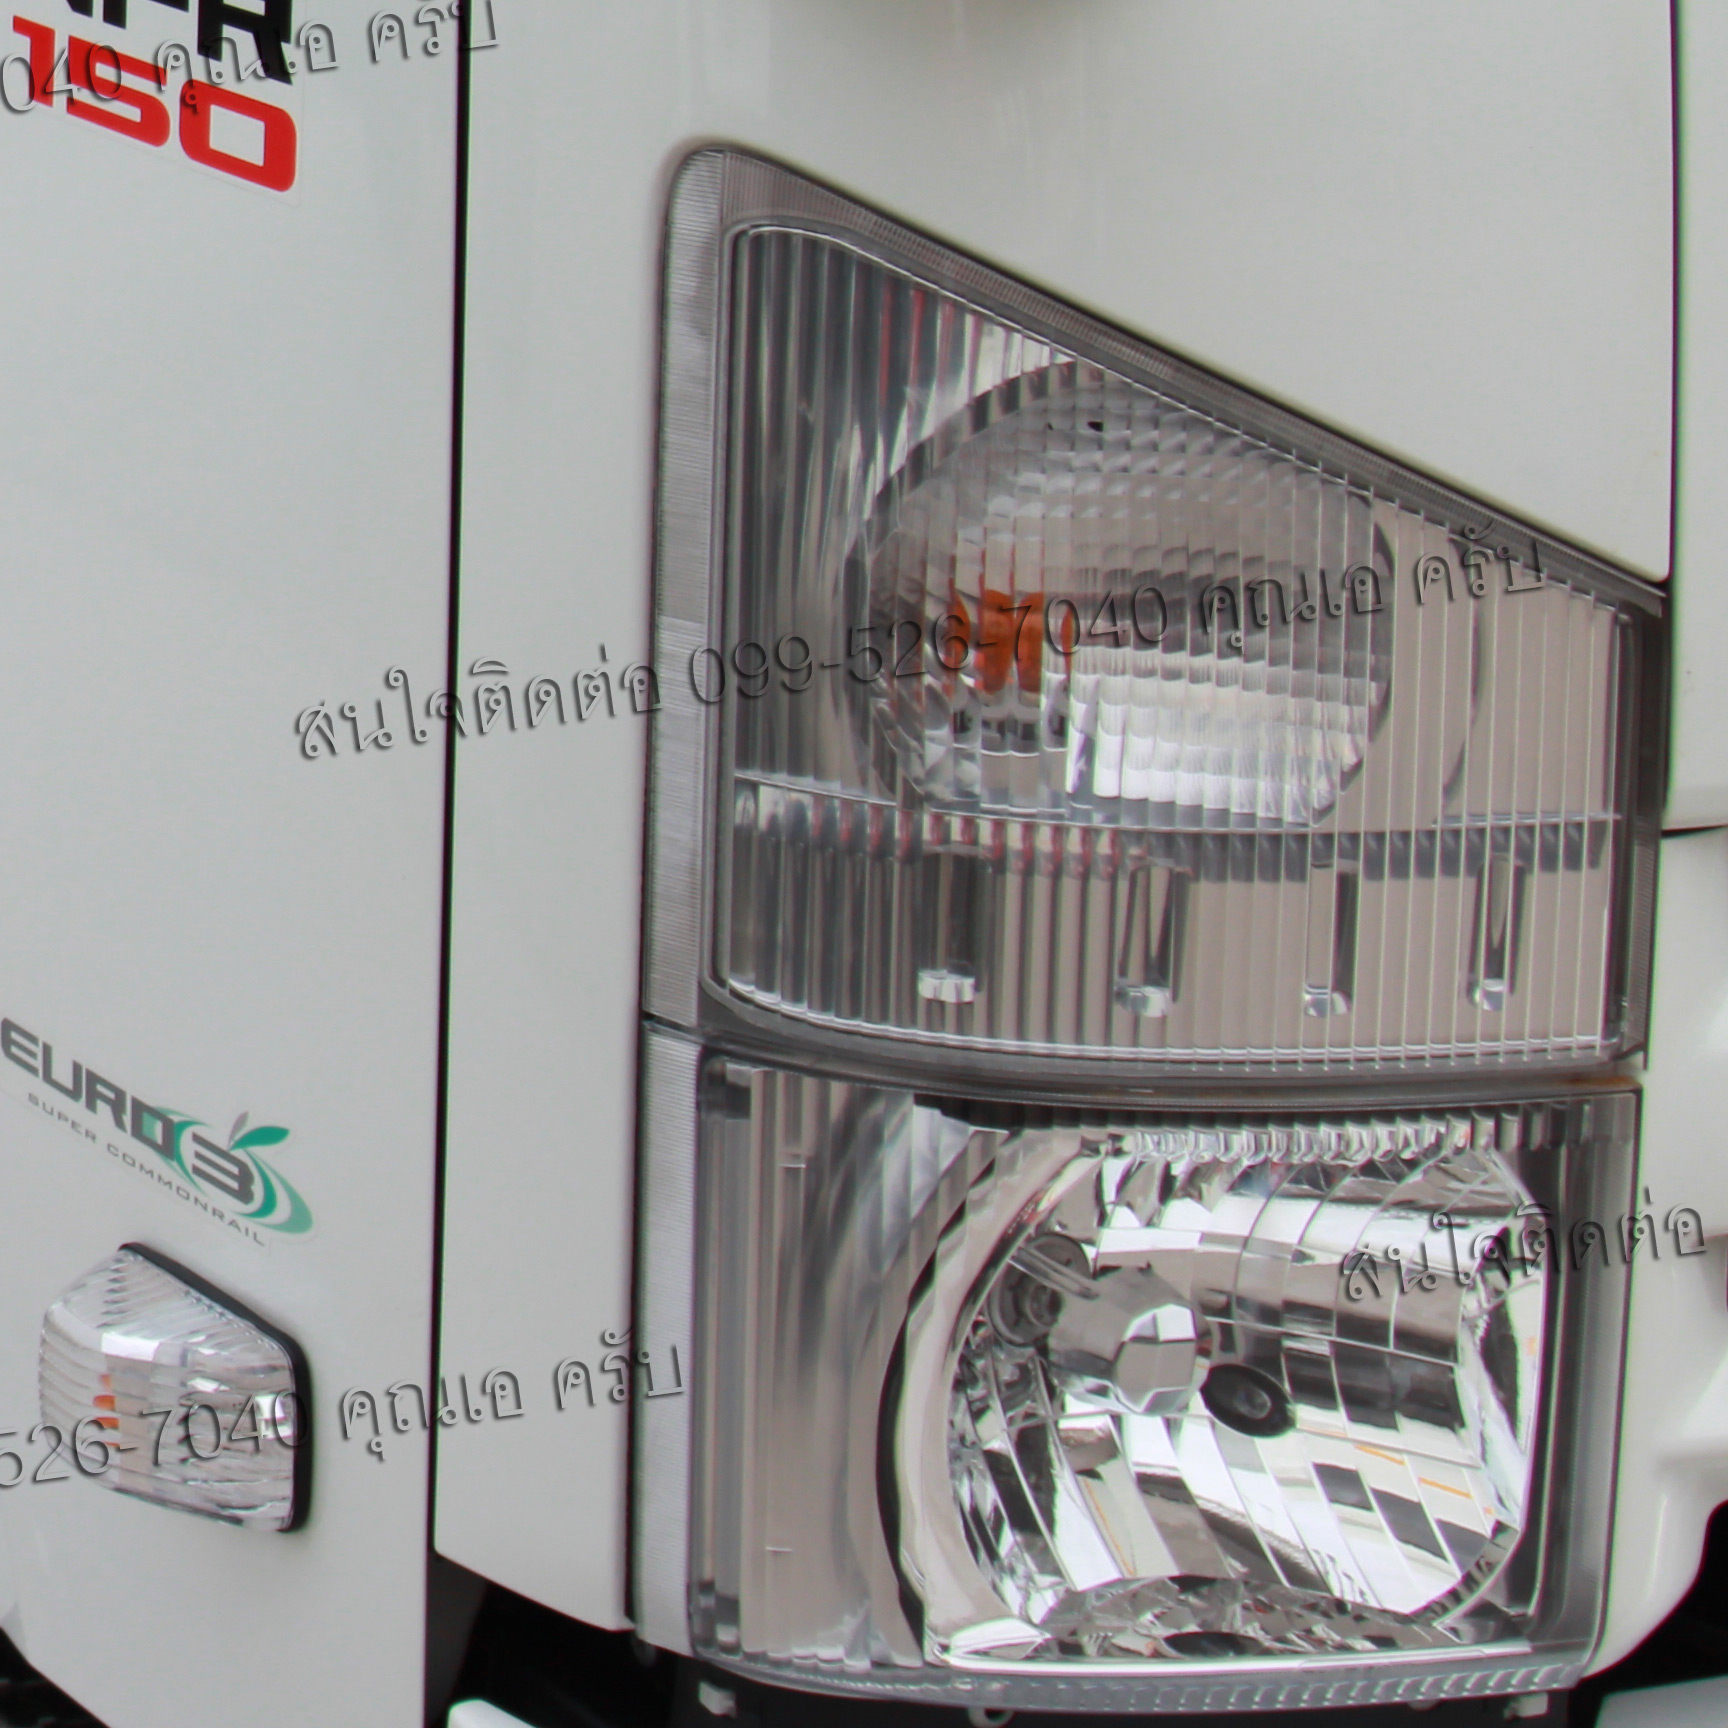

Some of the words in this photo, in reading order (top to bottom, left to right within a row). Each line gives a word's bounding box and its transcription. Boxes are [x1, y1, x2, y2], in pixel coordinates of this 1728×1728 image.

[12, 15, 297, 192] 150
[1, 1018, 175, 1161] EURO
[28, 1092, 96, 1144] SUPER
[106, 1143, 265, 1246] COMMONRAIL
